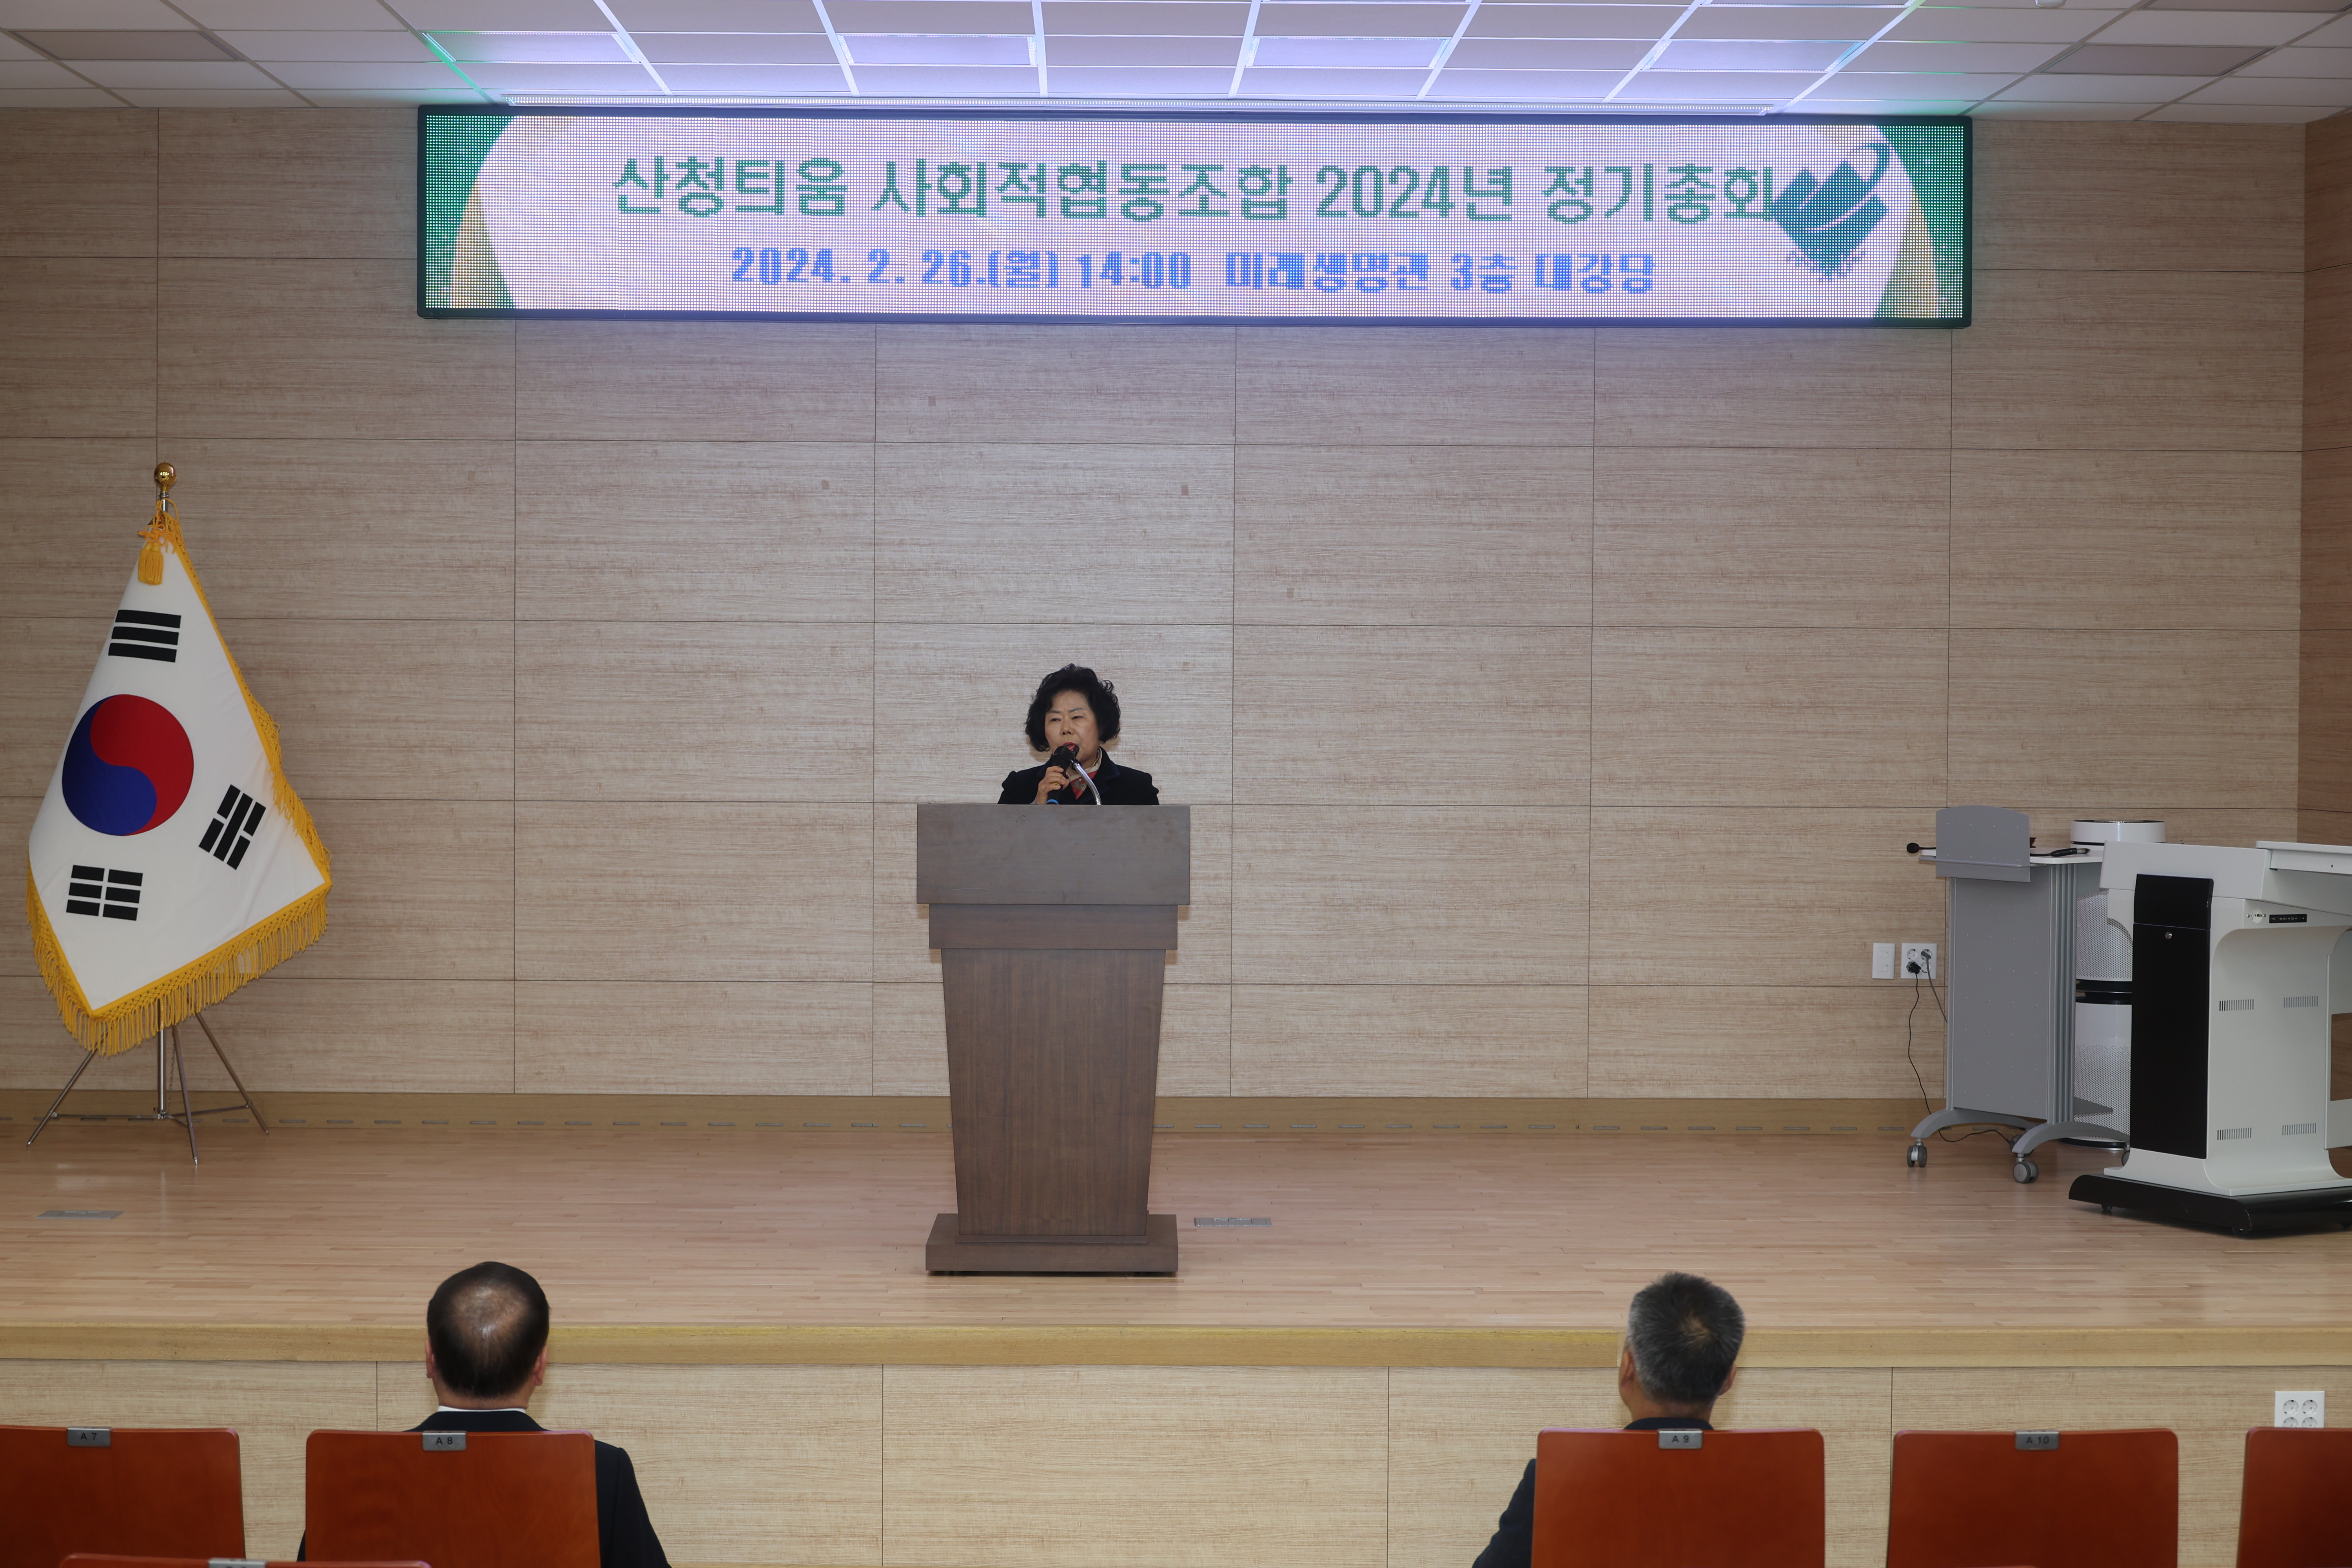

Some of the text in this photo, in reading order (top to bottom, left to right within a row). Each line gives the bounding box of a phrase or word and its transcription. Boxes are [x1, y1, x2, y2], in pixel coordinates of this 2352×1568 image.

[612, 156, 1773, 224] 산청틔움 사회적협동조합 2024년 정기총회
[732, 247, 1656, 294] 2024. 2. 26.(월) 14:00 미래생명관 3층 대강당
